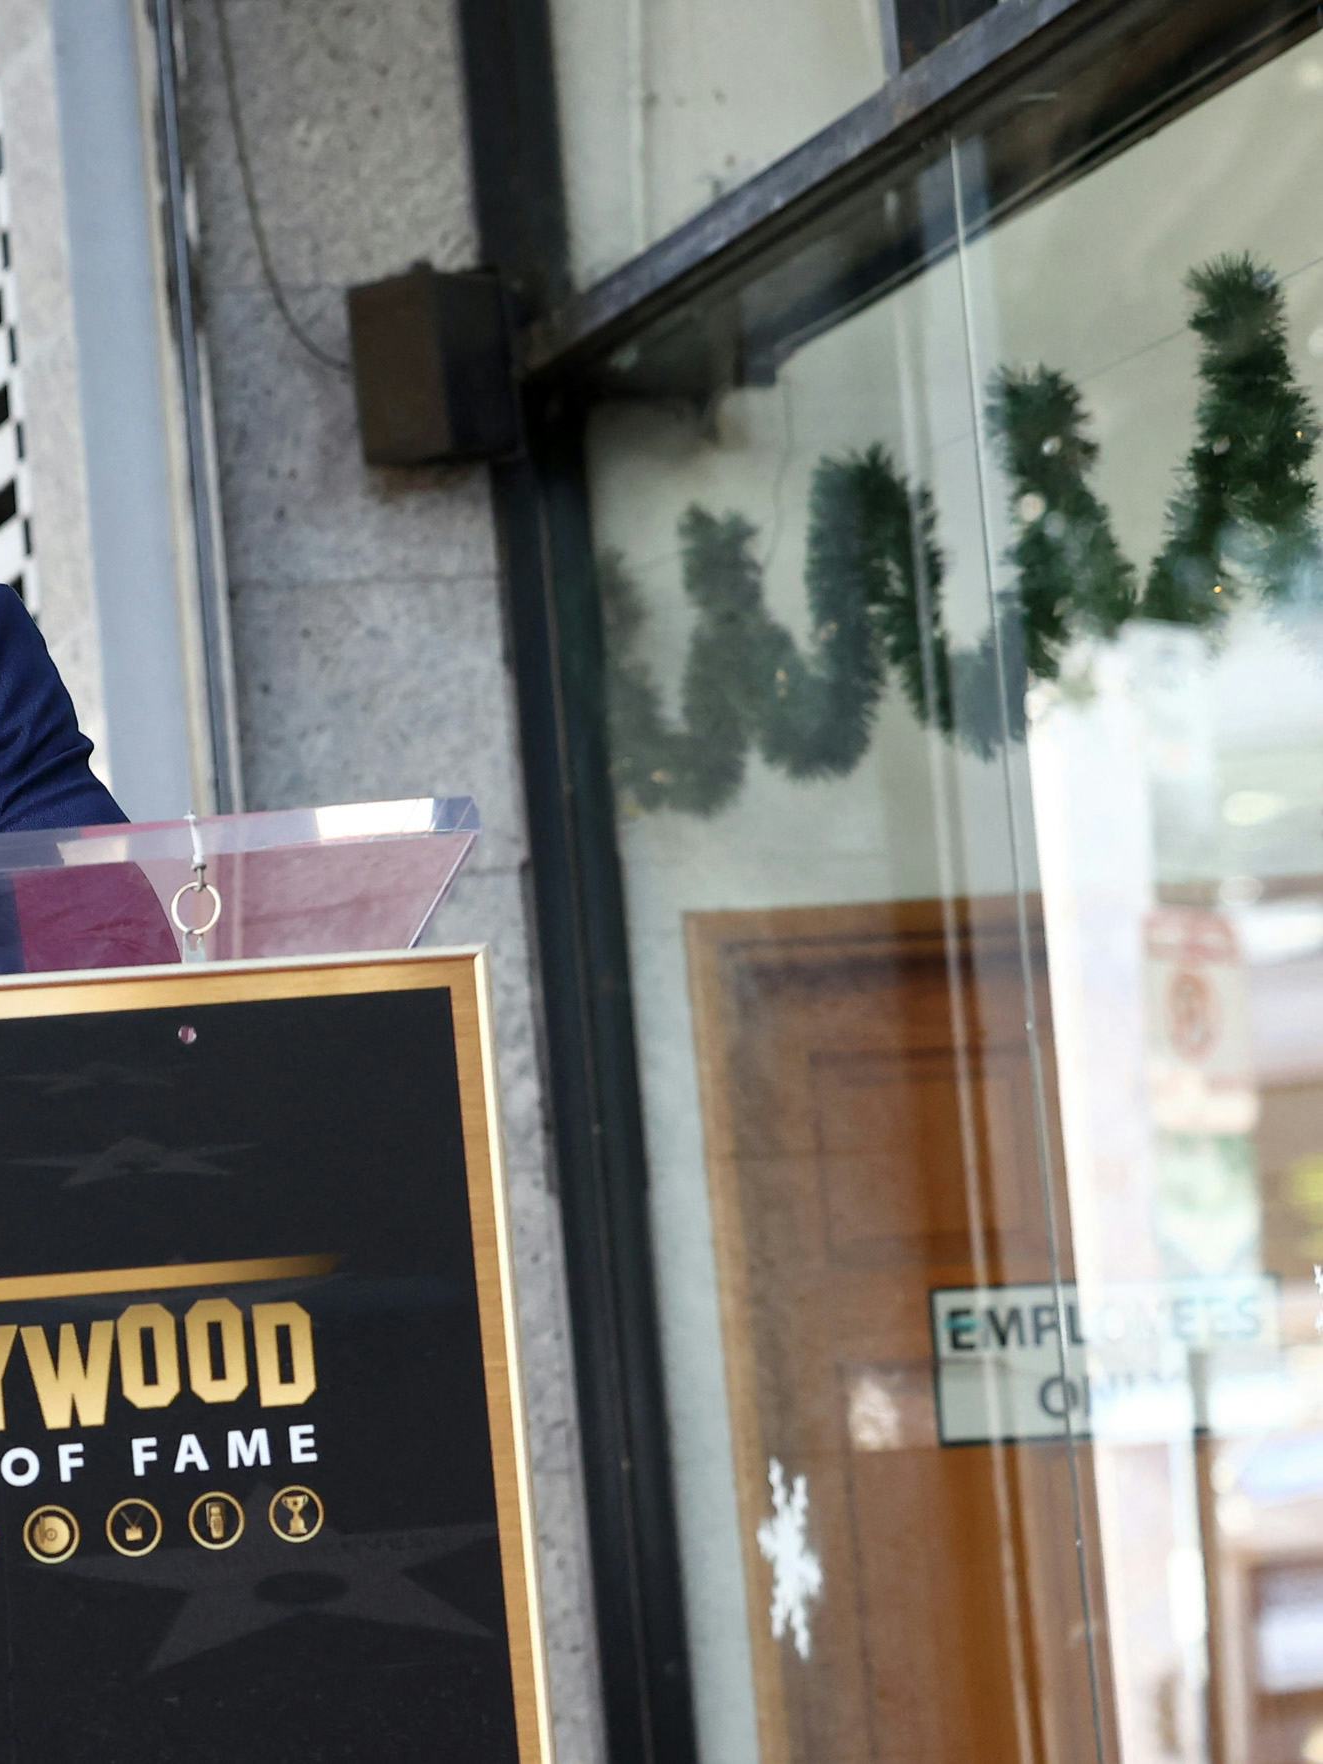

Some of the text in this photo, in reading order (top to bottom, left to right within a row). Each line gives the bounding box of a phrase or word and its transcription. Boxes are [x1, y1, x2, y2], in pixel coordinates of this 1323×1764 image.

[948, 1294, 1263, 1351] EMPLOEES
[0, 1442, 85, 1487] OF
[131, 1424, 318, 1477] FAME
